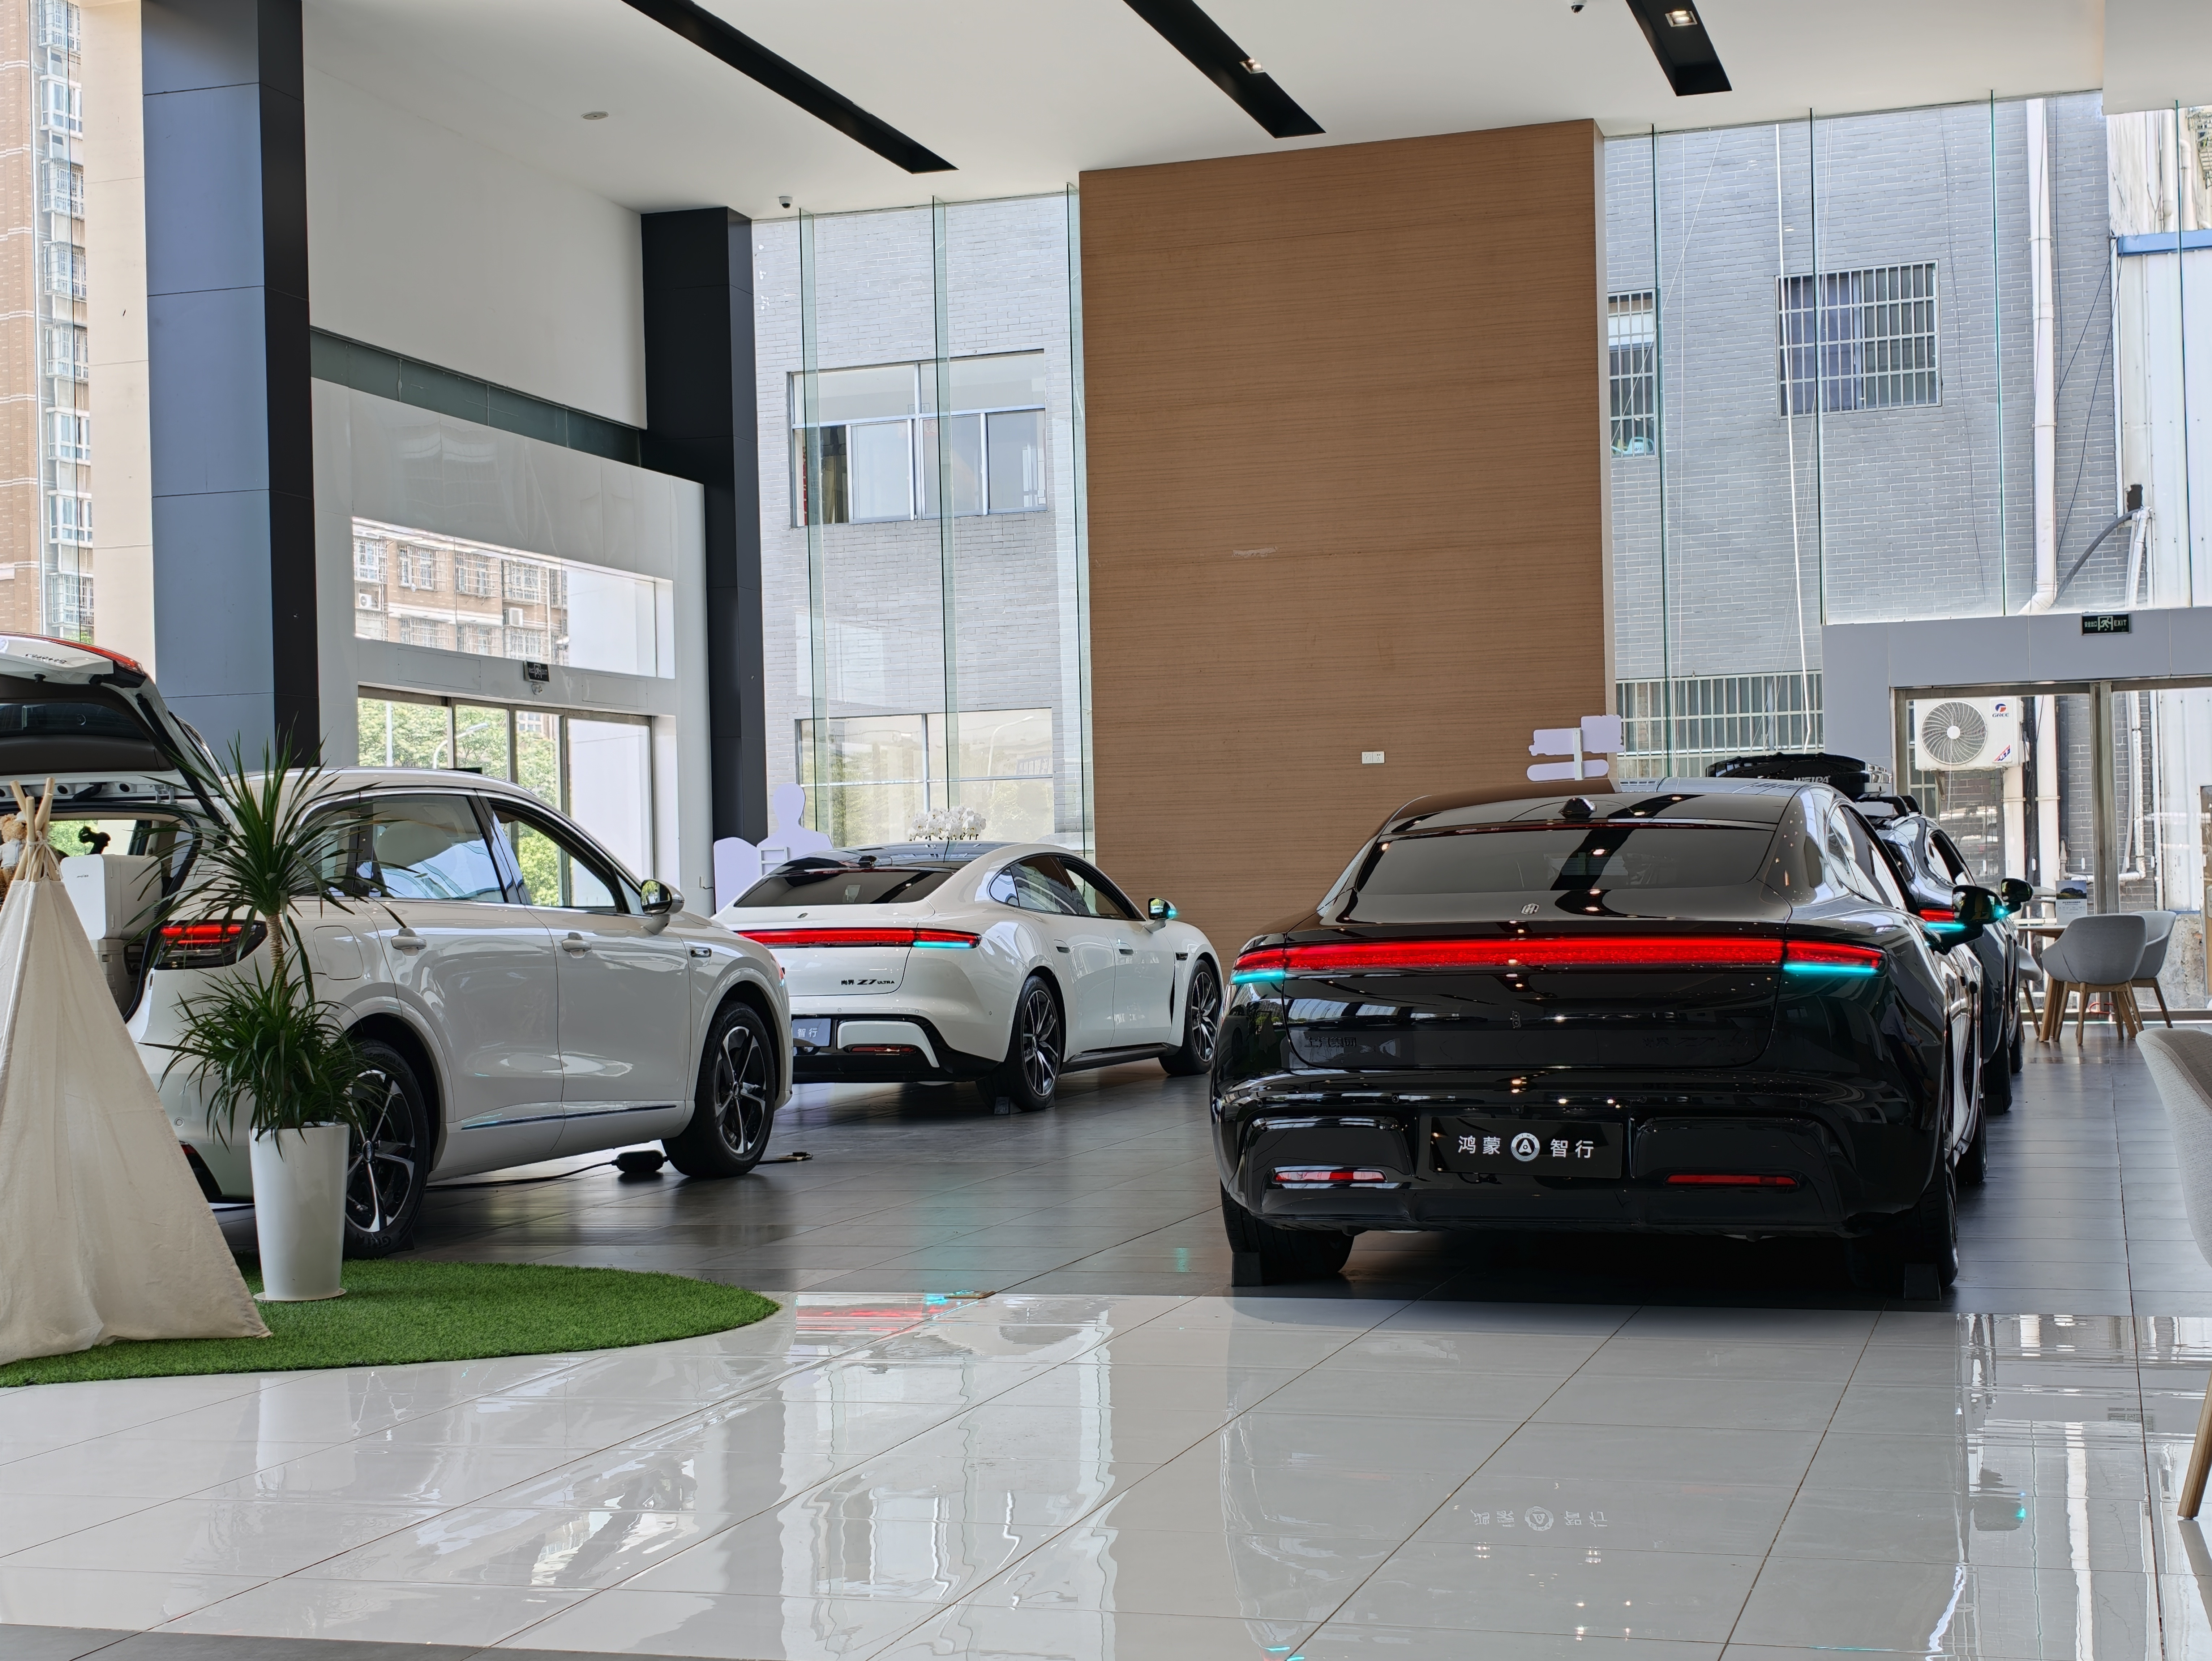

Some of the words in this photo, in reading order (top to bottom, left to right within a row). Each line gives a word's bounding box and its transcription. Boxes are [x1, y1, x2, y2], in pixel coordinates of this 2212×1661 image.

[797, 1028, 818, 1038] 智行
[1304, 1036, 1357, 1048] 上汽集团
[1458, 1136, 1501, 1155] 鸿蒙
[1550, 1139, 1594, 1159] 智行
